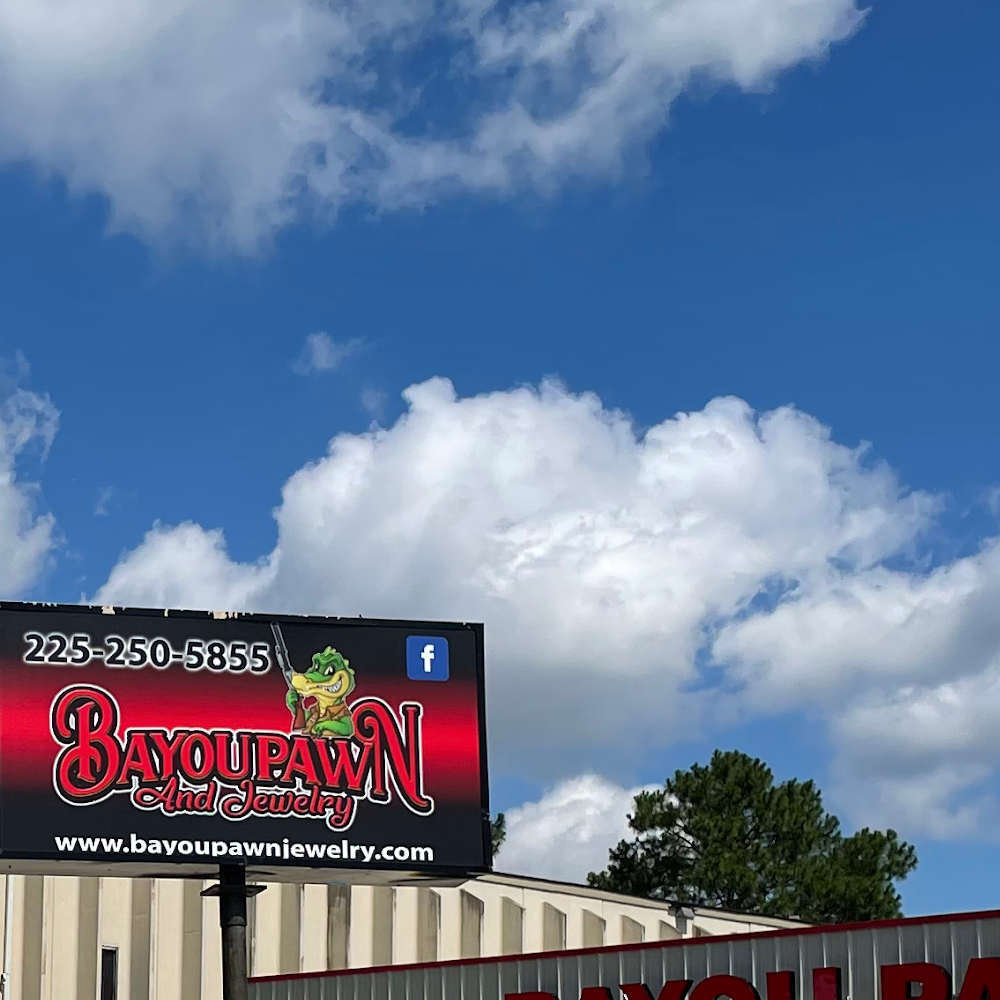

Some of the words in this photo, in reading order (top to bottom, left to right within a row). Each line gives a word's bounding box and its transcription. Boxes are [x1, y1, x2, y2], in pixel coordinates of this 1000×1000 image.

[22, 632, 271, 673] 225-250-5855
[134, 776, 216, 812] And
[222, 779, 352, 828] Jewelry
[54, 833, 435, 863] www.bayoupawnjewelry.com
